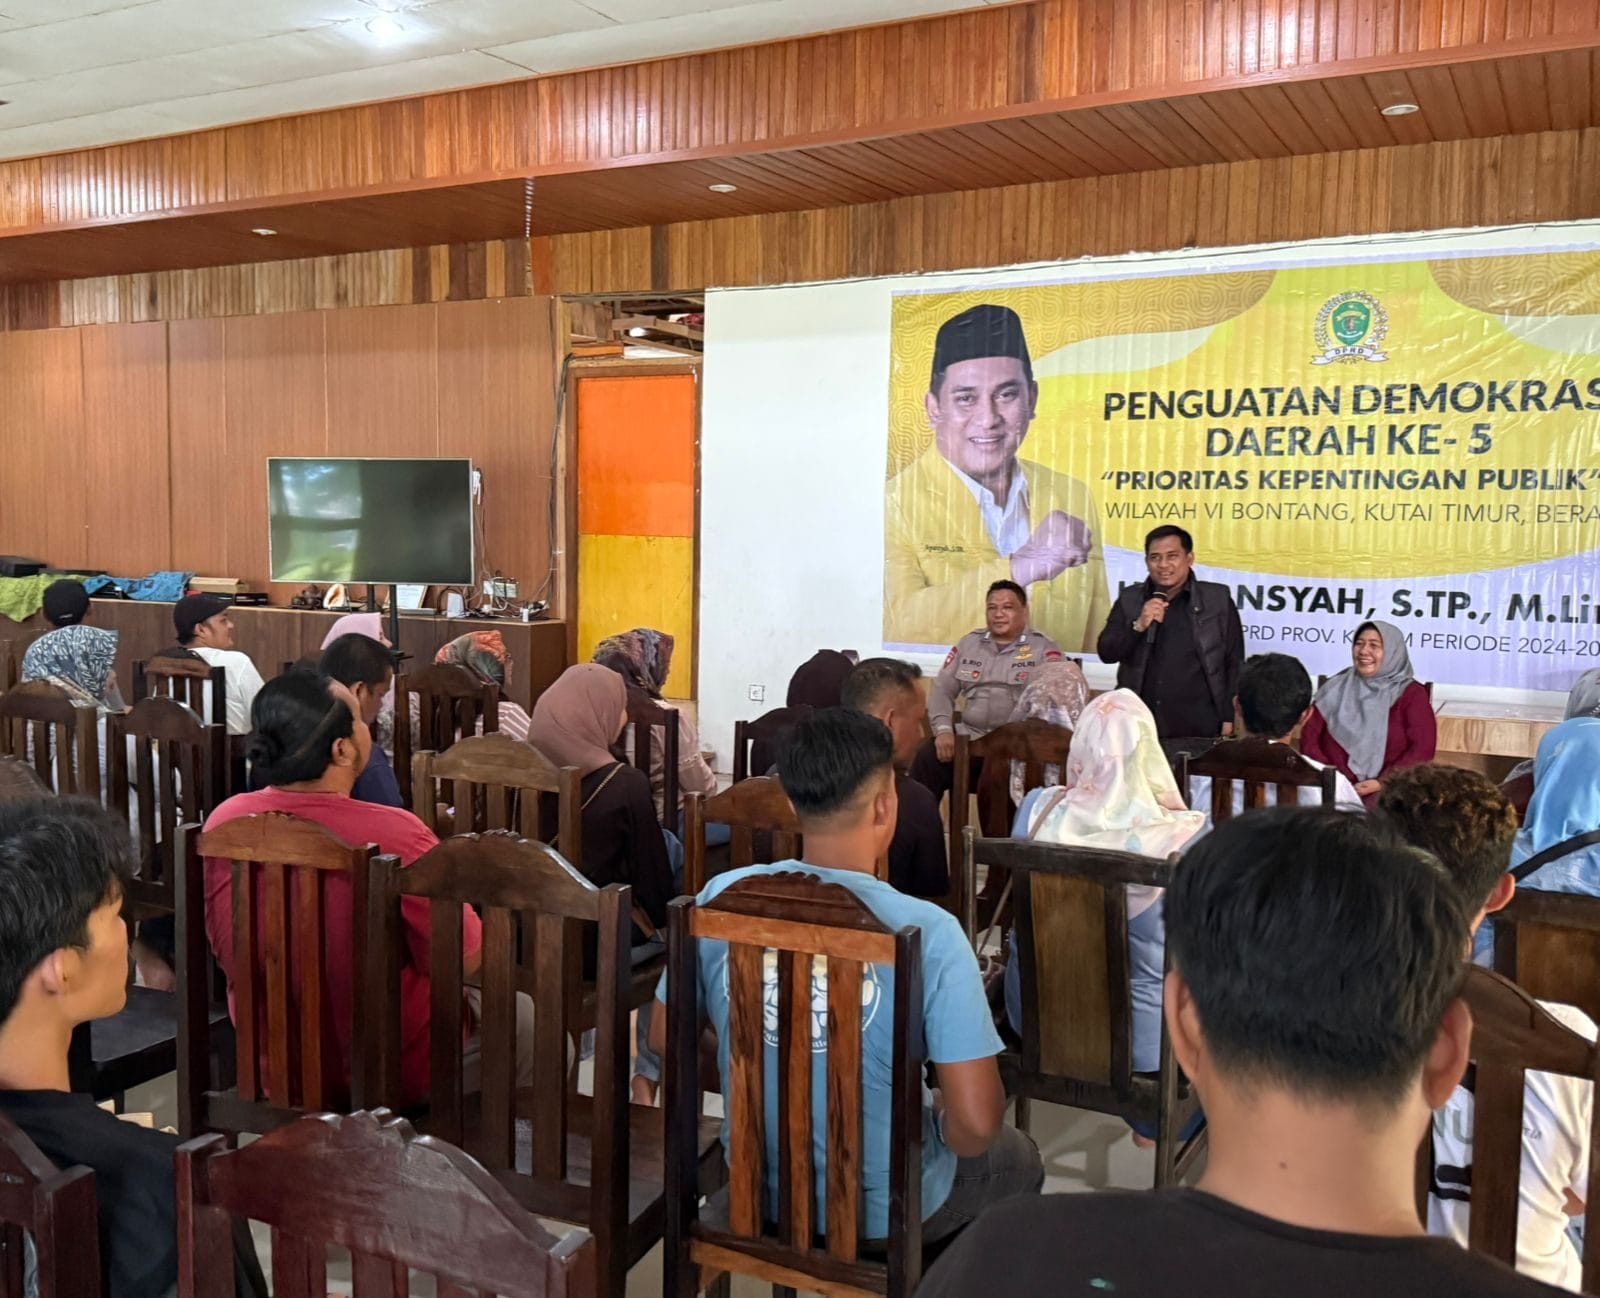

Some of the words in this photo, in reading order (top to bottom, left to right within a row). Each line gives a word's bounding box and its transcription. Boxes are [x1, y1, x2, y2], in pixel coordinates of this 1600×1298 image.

[1104, 385, 1341, 420] PENGUATAN
[1352, 378, 1600, 415] DEMOKRAS
[1206, 424, 1375, 457] DAERAH
[1387, 423, 1457, 455] KE-
[1468, 422, 1492, 454] 5
[1101, 469, 1248, 490] "PRIORITAS
[1259, 468, 1466, 490] KEPENTINGAN
[1105, 502, 1197, 519] WILAYAH
[1204, 502, 1223, 519] VI
[1232, 502, 1355, 524] BONTANG,
[1364, 502, 1432, 522] KUTAI
[1441, 503, 1525, 526] TIMUR,
[1236, 584, 1376, 619] NSYAH,
[1391, 588, 1491, 624] S.TP.,
[1505, 593, 1600, 624] M.Li
[1241, 624, 1275, 640] PRD
[1281, 626, 1335, 643] PROV.
[1420, 632, 1511, 652] PERIODE
